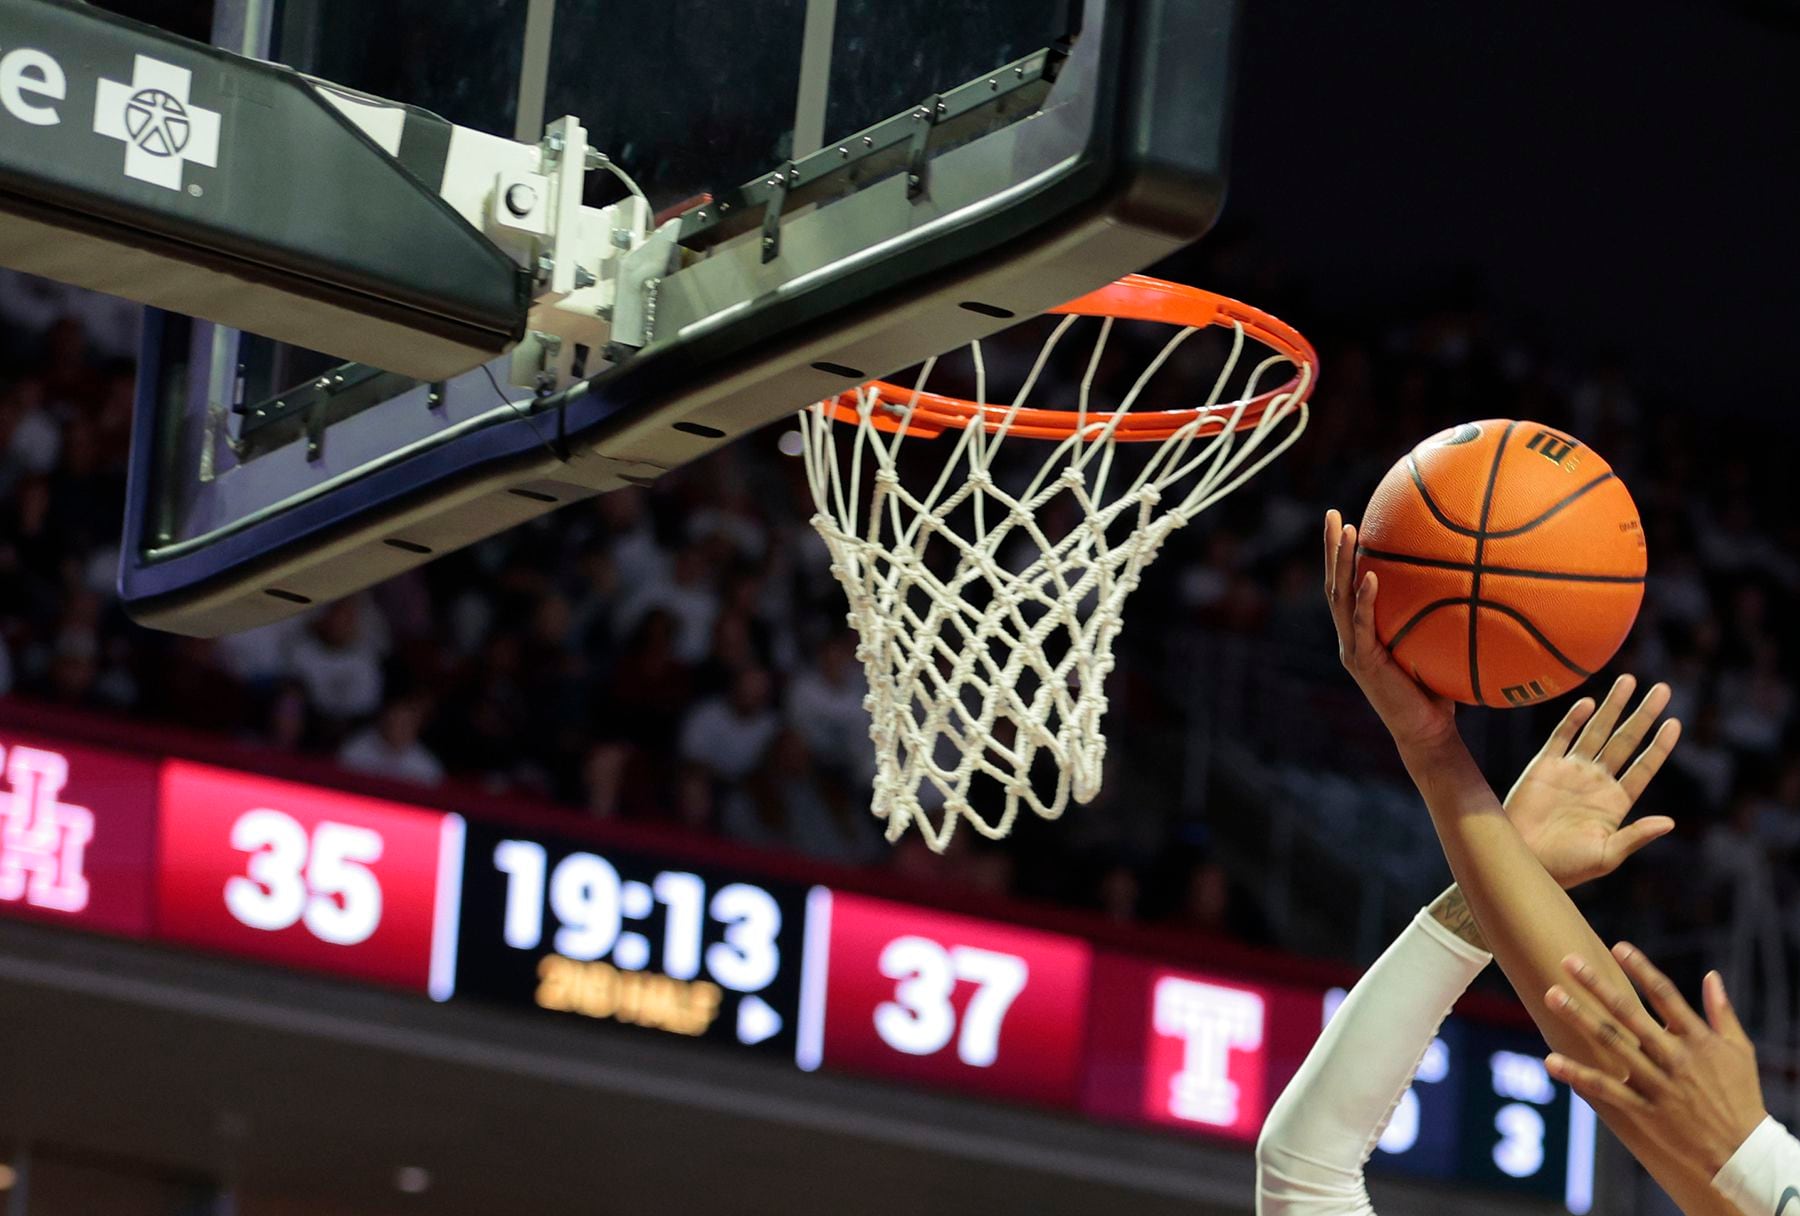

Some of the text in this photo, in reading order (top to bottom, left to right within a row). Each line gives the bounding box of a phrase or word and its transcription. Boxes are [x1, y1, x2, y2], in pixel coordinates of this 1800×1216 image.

[223, 807, 385, 946] 35
[493, 838, 782, 993] 19:13
[873, 934, 1029, 1068] 37
[1492, 1102, 1546, 1178] 3
